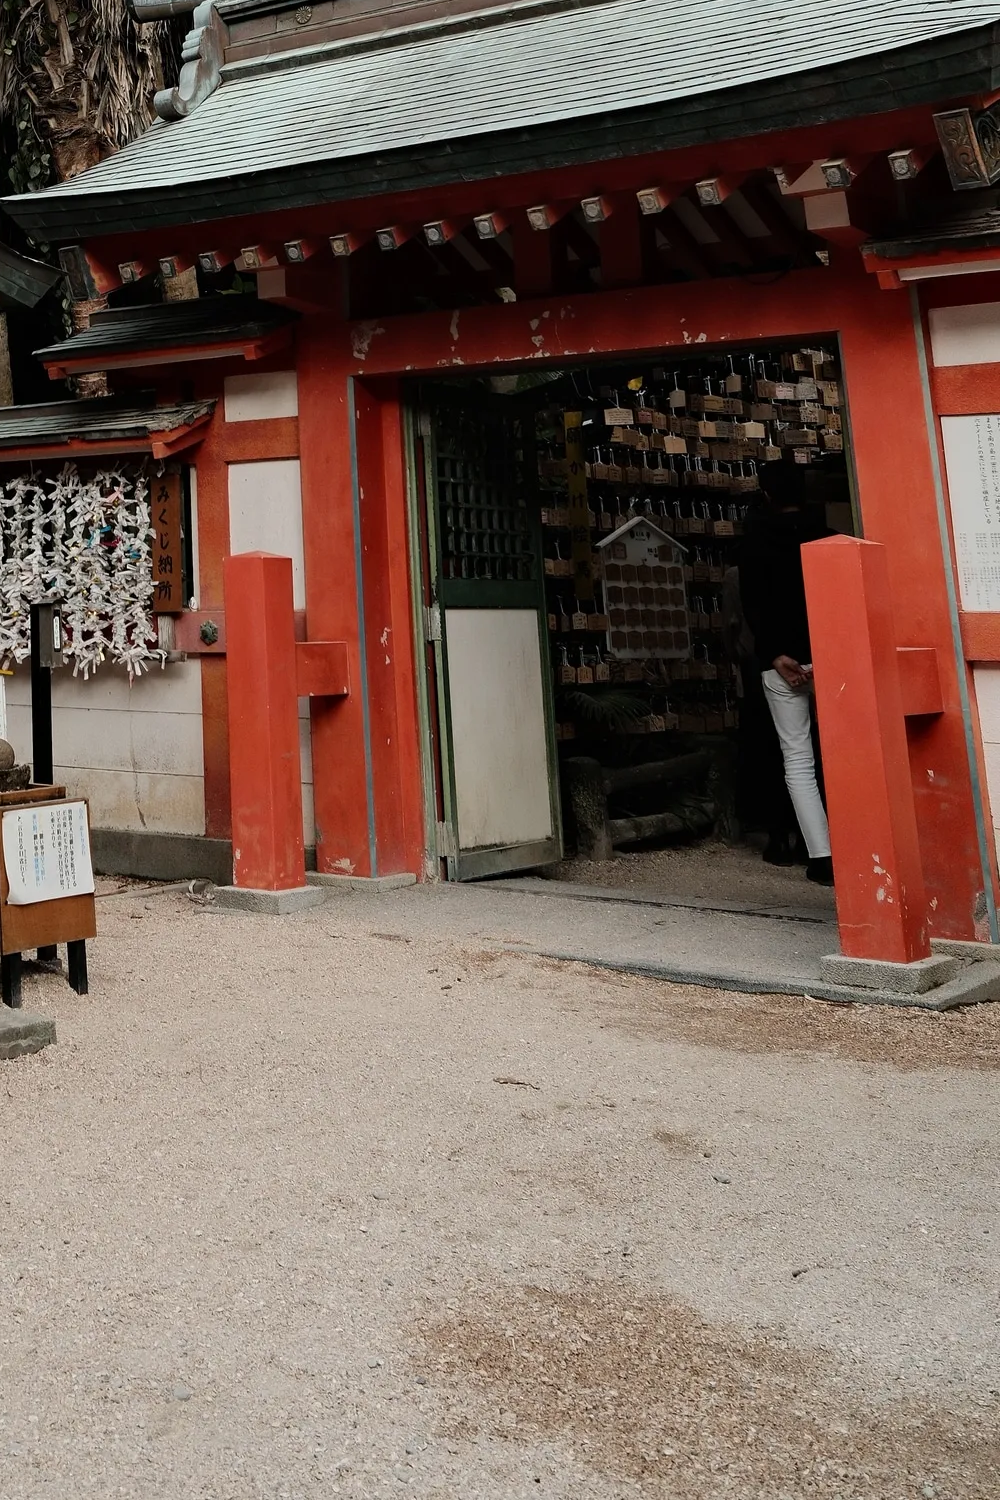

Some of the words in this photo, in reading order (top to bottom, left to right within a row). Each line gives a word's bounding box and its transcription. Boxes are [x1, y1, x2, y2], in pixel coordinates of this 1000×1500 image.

[157, 485, 173, 600] みくじ納所
